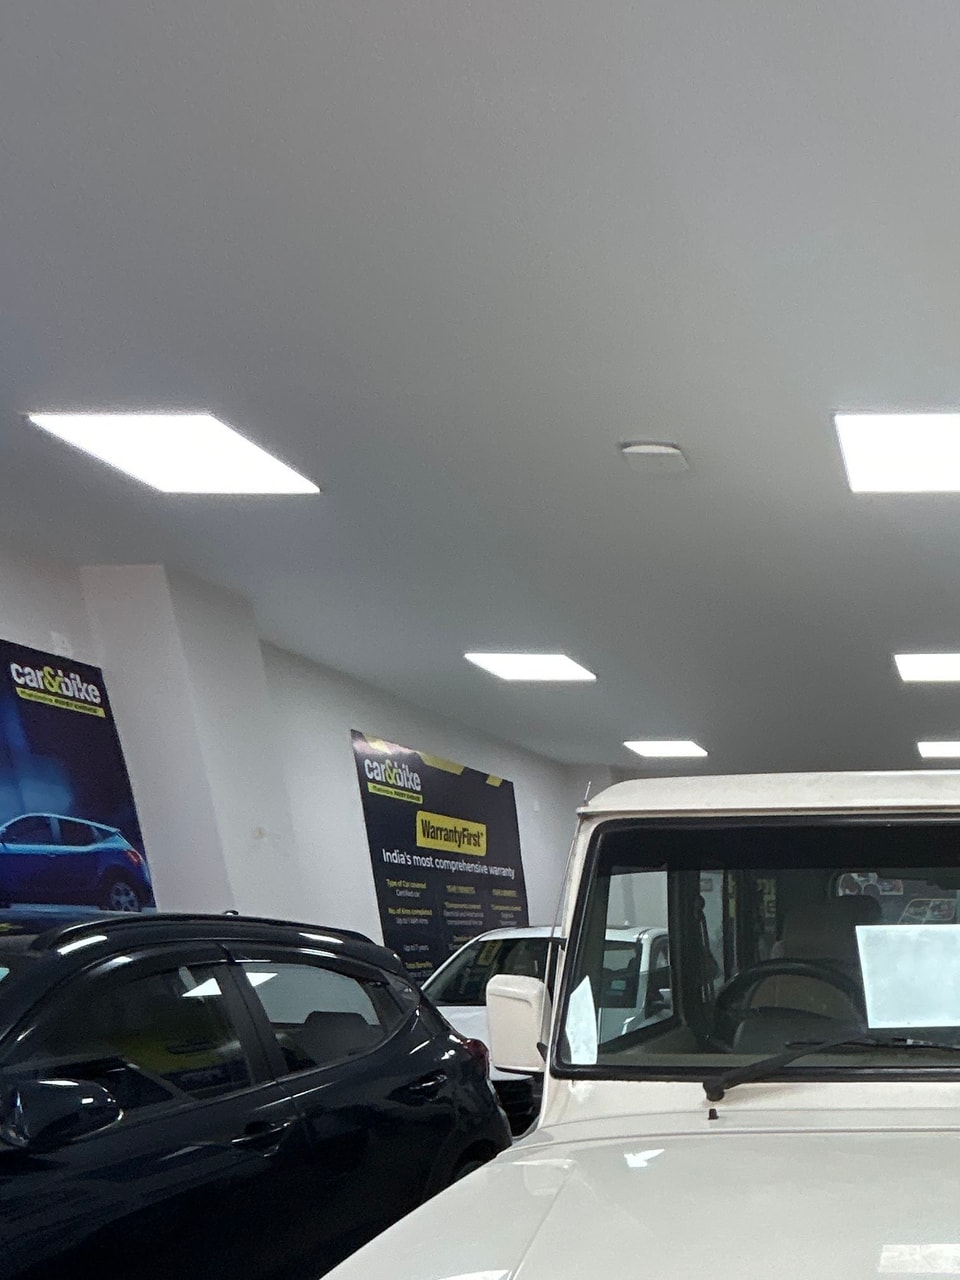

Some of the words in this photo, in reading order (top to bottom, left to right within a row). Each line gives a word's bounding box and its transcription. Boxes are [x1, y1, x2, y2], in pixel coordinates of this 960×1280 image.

[10, 662, 101, 703] car&bike
[364, 759, 421, 791] car&bike
[382, 848, 412, 864] India's
[413, 855, 434, 868] most
[435, 857, 488, 875] comprehensive
[488, 864, 515, 880] warranty
